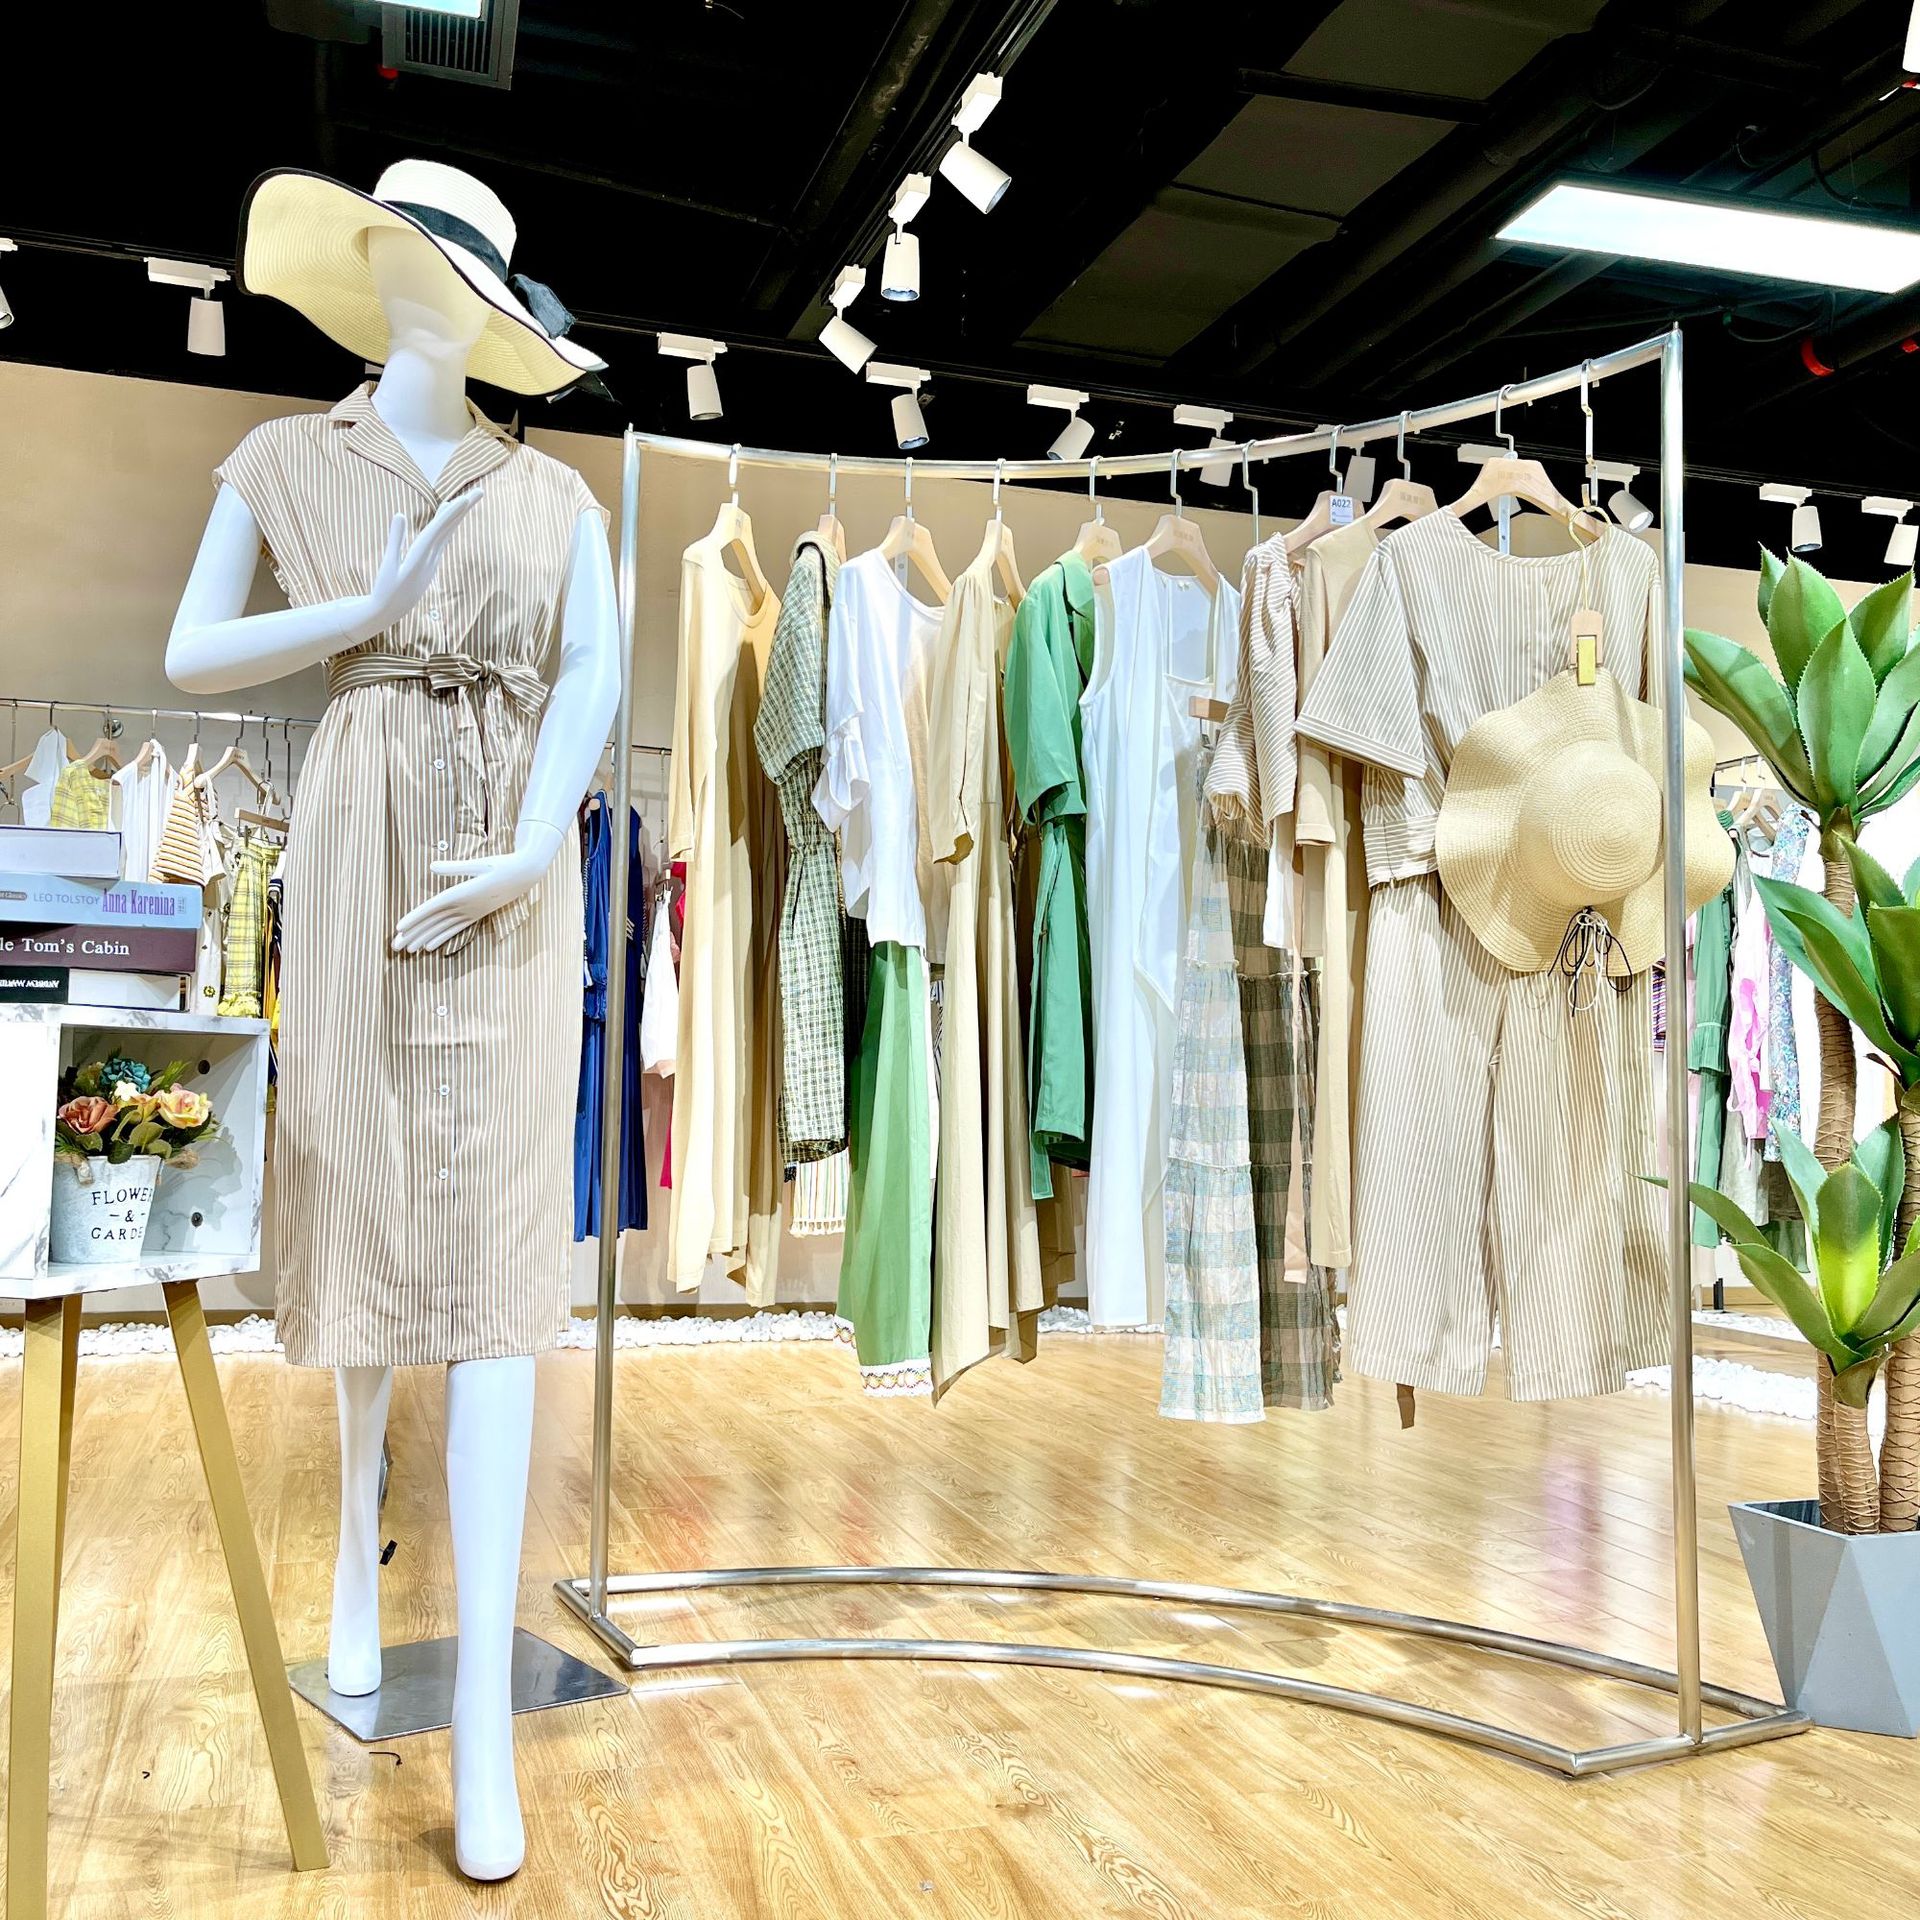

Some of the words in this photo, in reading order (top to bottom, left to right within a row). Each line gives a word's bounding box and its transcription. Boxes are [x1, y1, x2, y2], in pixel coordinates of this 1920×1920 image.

[1332, 498, 1351, 508] A022
[33, 892, 53, 903] LEO
[55, 894, 100, 905] TOLSTOY
[102, 887, 127, 914] Anna
[130, 889, 175, 916] Karenina
[81, 940, 130, 955] Cabin
